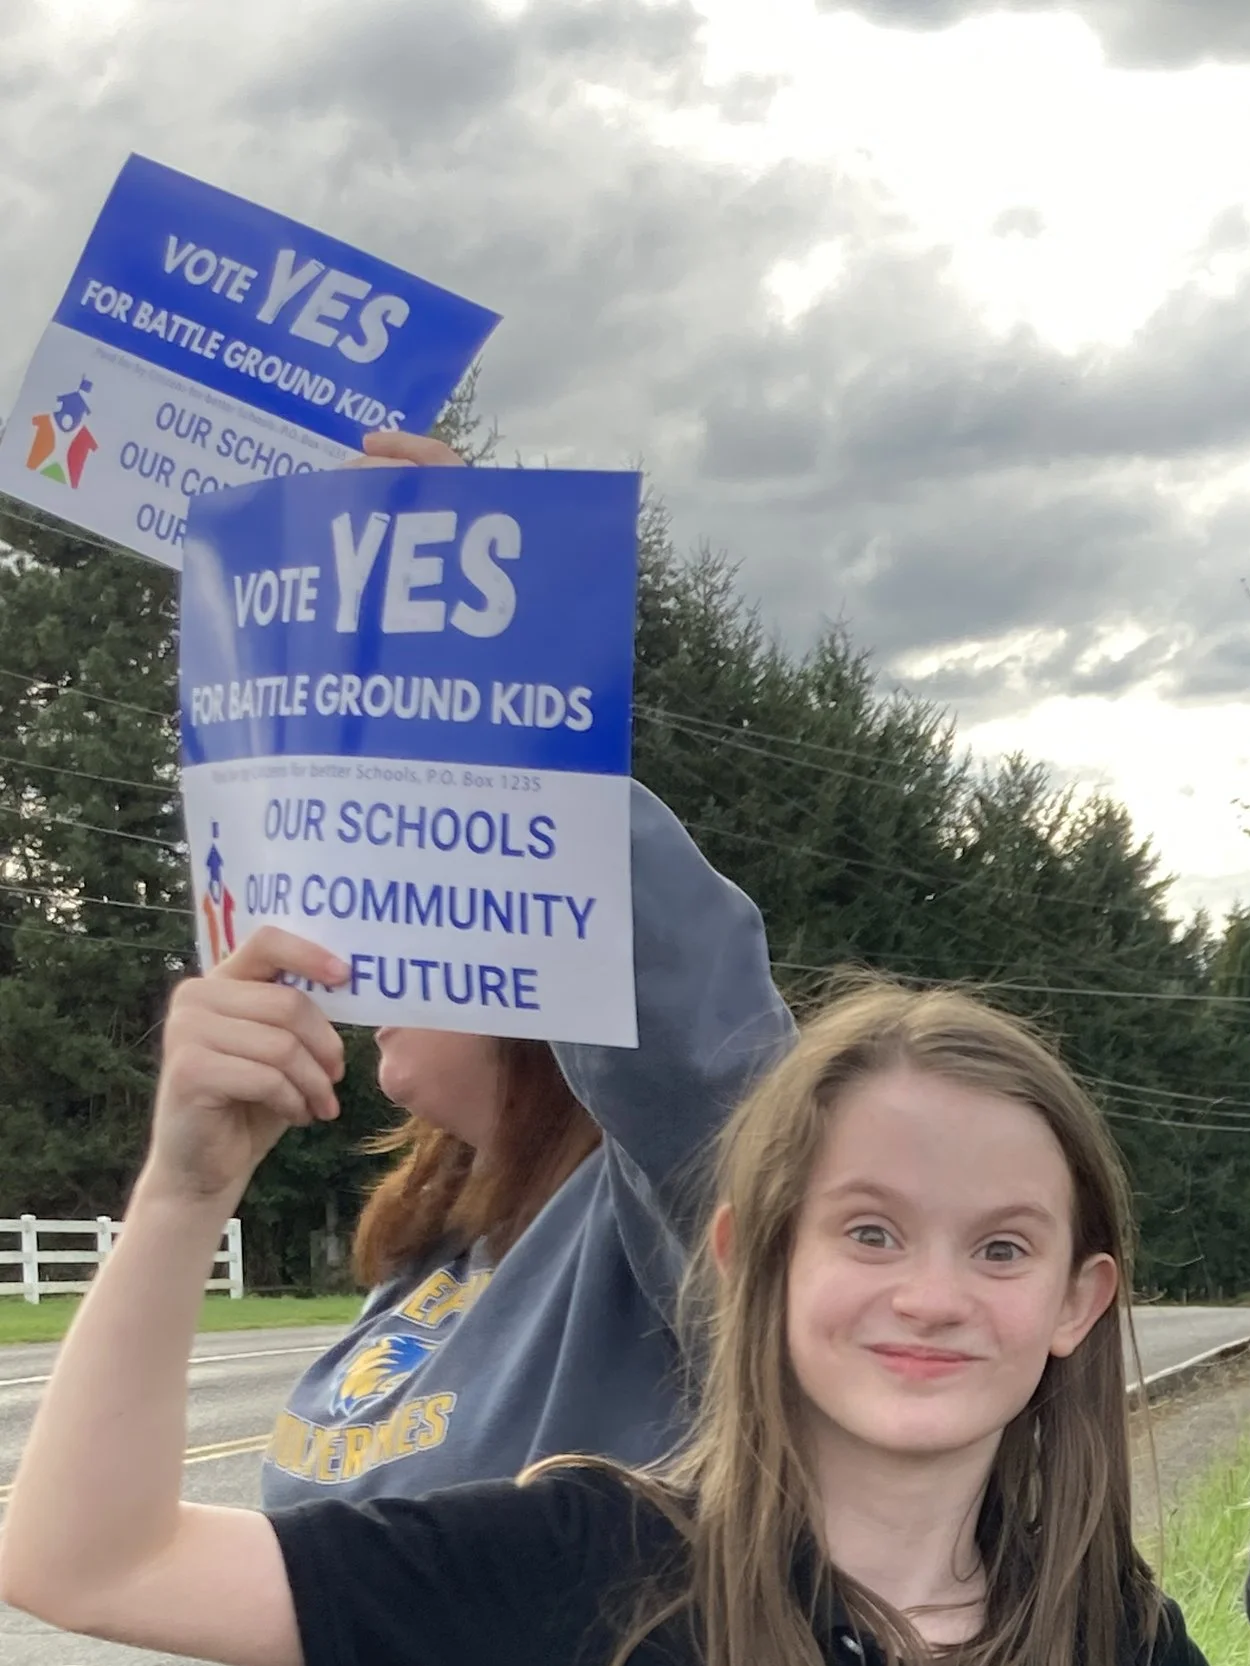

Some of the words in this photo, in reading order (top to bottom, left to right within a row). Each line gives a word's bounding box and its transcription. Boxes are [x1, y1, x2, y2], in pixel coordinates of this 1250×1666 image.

[165, 236, 258, 302] VOTE
[256, 249, 409, 363] YES
[81, 280, 133, 322] FOR
[133, 301, 225, 359] BATTLE
[224, 341, 335, 404] GROUND
[335, 389, 406, 433] KIDS
[120, 442, 175, 487] OUR
[156, 403, 212, 448] OUR
[216, 429, 323, 477] SCHO
[232, 566, 319, 629] VOTE
[331, 511, 520, 637] YES
[192, 684, 225, 725] FOR
[228, 675, 309, 724] BATTLE
[314, 674, 480, 721] GROUND
[491, 682, 592, 730] KIDS
[310, 763, 351, 779] better
[427, 769, 457, 786] P.O.
[462, 771, 494, 789] Box
[502, 774, 542, 792] 1235
[265, 799, 326, 841] OUR
[338, 801, 556, 859] SCHOOLS
[246, 873, 291, 915] OUR
[303, 875, 596, 939] COMMUNITY
[349, 954, 539, 1009] FUTURE
